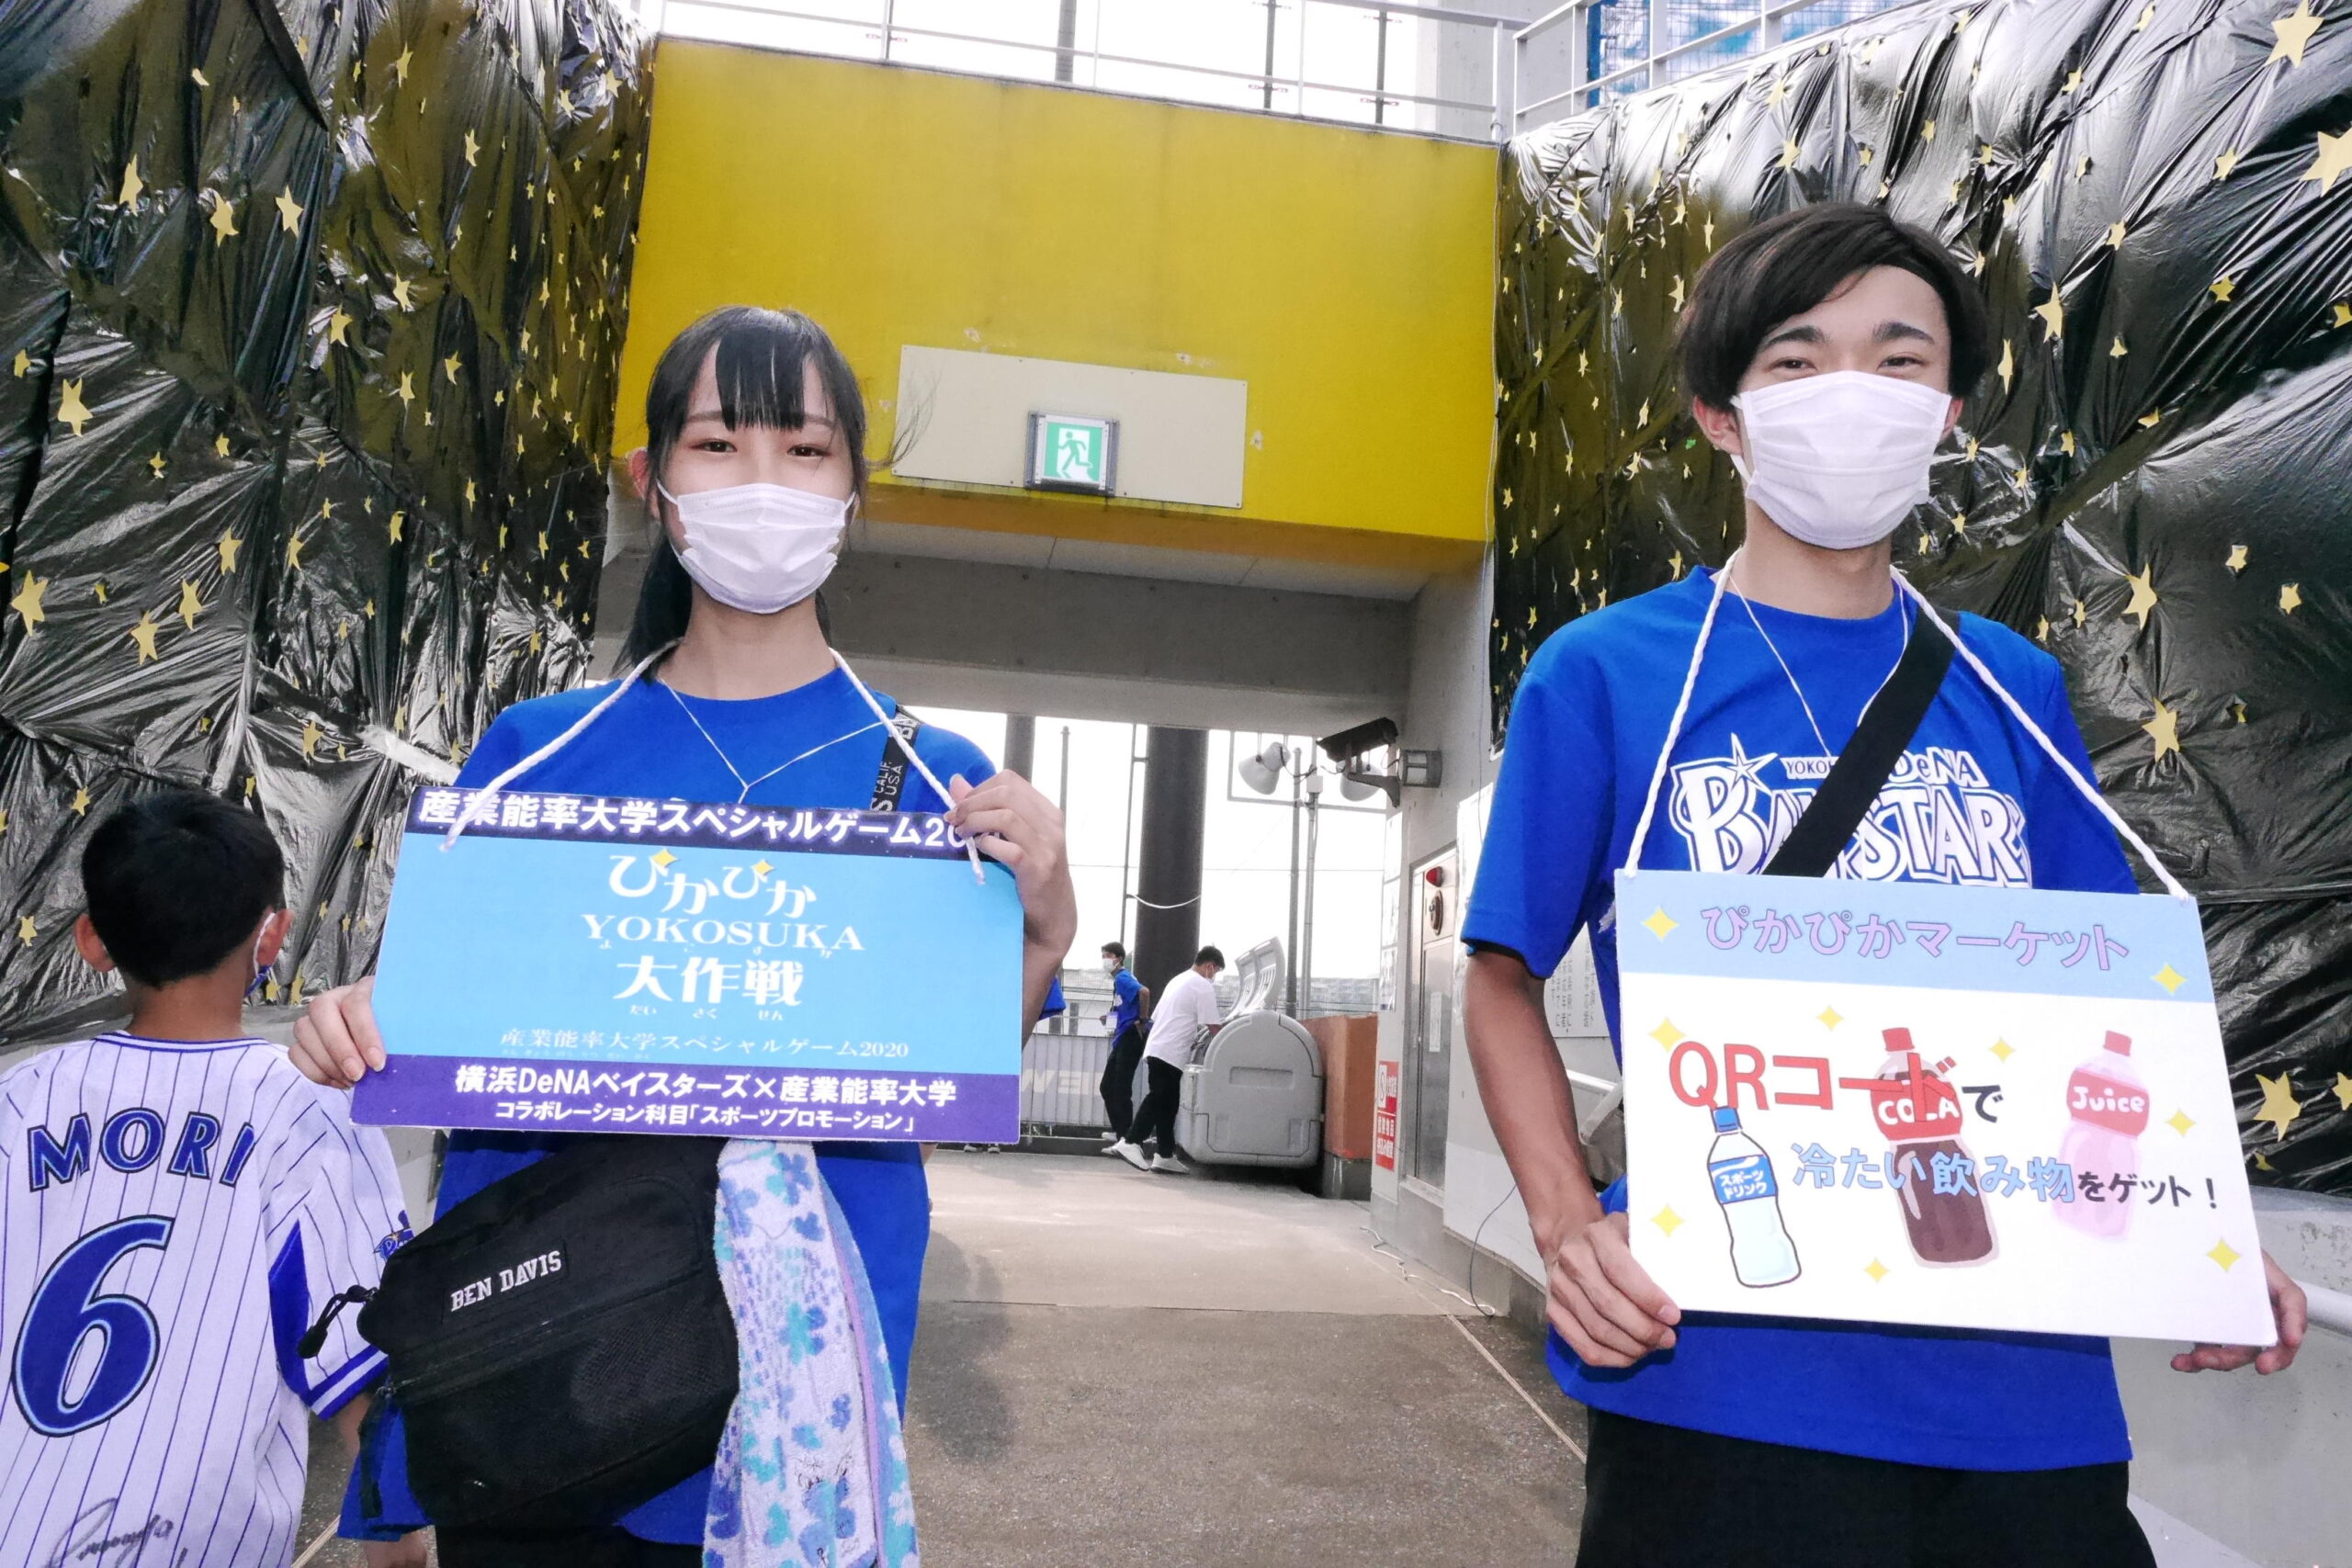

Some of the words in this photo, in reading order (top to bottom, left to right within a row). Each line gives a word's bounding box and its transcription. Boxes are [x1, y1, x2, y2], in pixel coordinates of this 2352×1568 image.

[884, 764, 904, 796] USA
[582, 913, 866, 952] YOKOSUKA
[1701, 903, 2130, 971] ぴかぴかマーケット
[613, 955, 805, 1008] 大作戦
[500, 1026, 910, 1058] 産業能率大学スペシャルゲーム2020
[455, 1066, 956, 1106] 横浜DeNAベイスターズ×産業能率大学
[2073, 1085, 2146, 1114] Juice
[494, 1100, 915, 1131] コラボレーション科目「スポーツプロモーション」
[28, 1106, 254, 1192] MORI
[1719, 1168, 1765, 1188] スポーツ
[1723, 1180, 1769, 1201] ドリンク
[449, 1277, 492, 1312] BEN
[499, 1250, 562, 1292] DAVIS
[12, 1214, 175, 1437] 6
